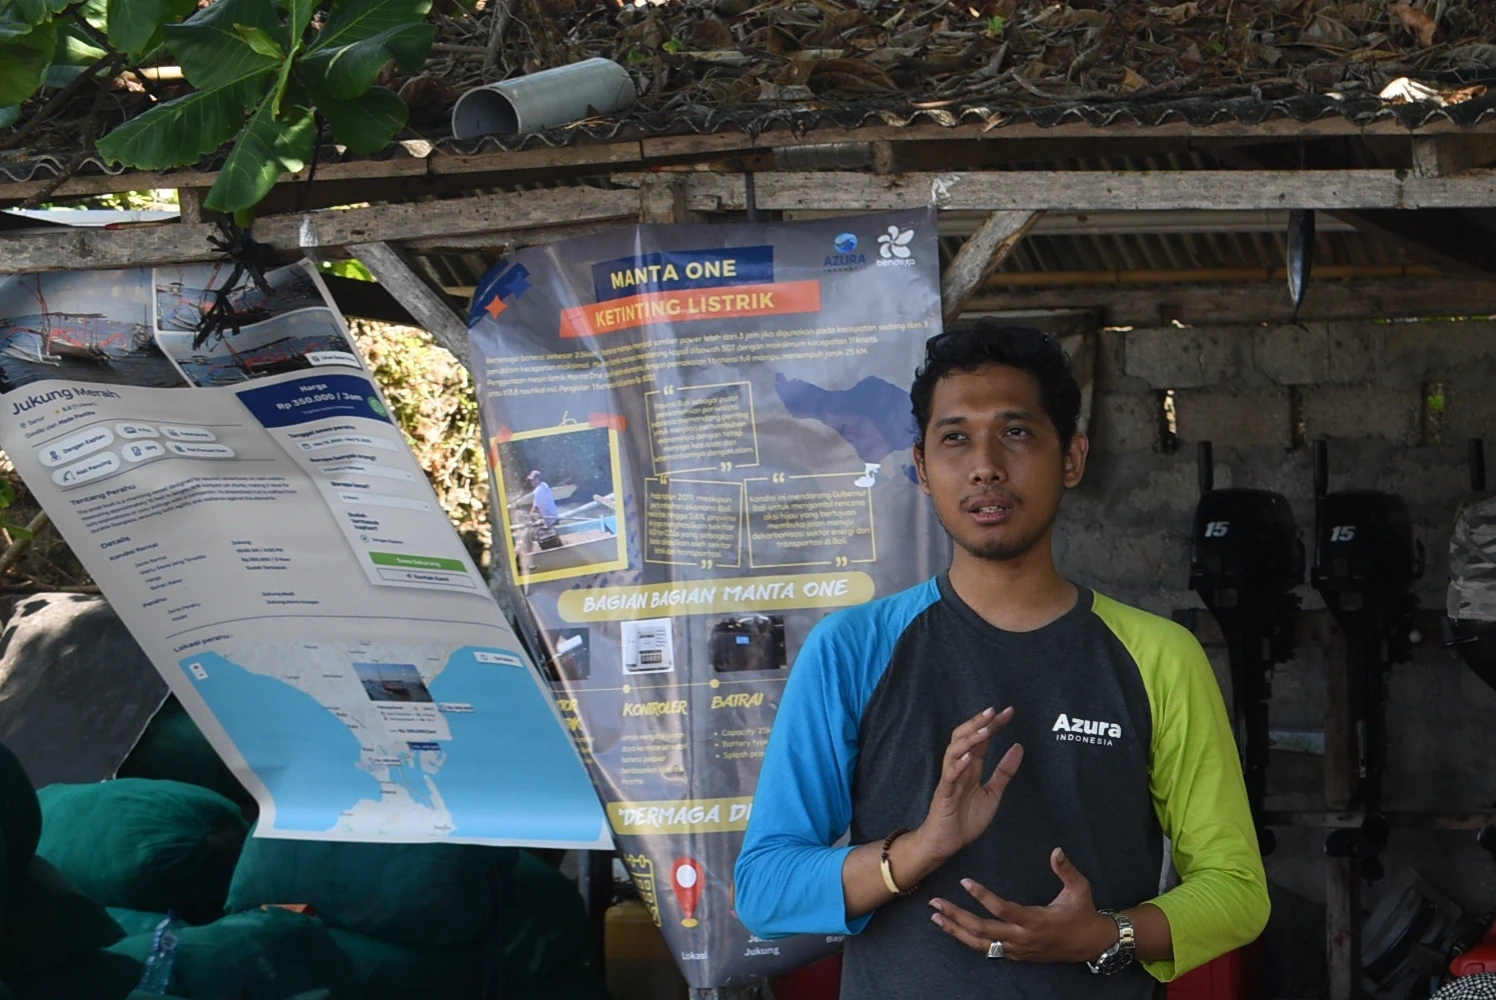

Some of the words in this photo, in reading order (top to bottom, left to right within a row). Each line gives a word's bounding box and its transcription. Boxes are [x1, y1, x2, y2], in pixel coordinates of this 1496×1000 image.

[823, 254, 866, 267] AZURA
[610, 264, 680, 289] MANTA
[685, 259, 737, 280] ONE
[595, 299, 681, 327] KETINTING
[688, 292, 775, 314] LISTRIK
[816, 327, 836, 336] pada
[837, 324, 878, 334] kecepatan
[879, 322, 906, 332] sedang
[737, 343, 765, 352] dengan
[808, 337, 848, 347] kecepatan
[298, 384, 328, 393] Harga
[13, 388, 74, 415] Jukung
[72, 386, 122, 399] Merah
[276, 401, 292, 411] Rp
[293, 393, 335, 408] 350.000
[342, 392, 364, 402] Jam
[63, 442, 84, 454] Dengan
[85, 434, 106, 445] Kapten
[69, 492, 106, 506] Tentang
[106, 484, 137, 496] Perahu
[787, 491, 831, 501] mendorong
[790, 500, 833, 511] mengambil
[799, 511, 819, 520] yang
[1205, 521, 1230, 537] 15
[1330, 525, 1356, 542] 15
[100, 535, 131, 550] Details
[583, 592, 649, 613] BAGIAN
[650, 586, 717, 610] BAGIAN
[723, 583, 795, 602] MANTA
[803, 579, 849, 597] ONE
[622, 700, 688, 717] KONTROLER
[711, 693, 764, 709] BATRAI
[1052, 713, 1122, 739] Azura
[1056, 733, 1113, 747] INDONESIA
[682, 952, 708, 960] Lokasi
[744, 946, 780, 957] Jukung
